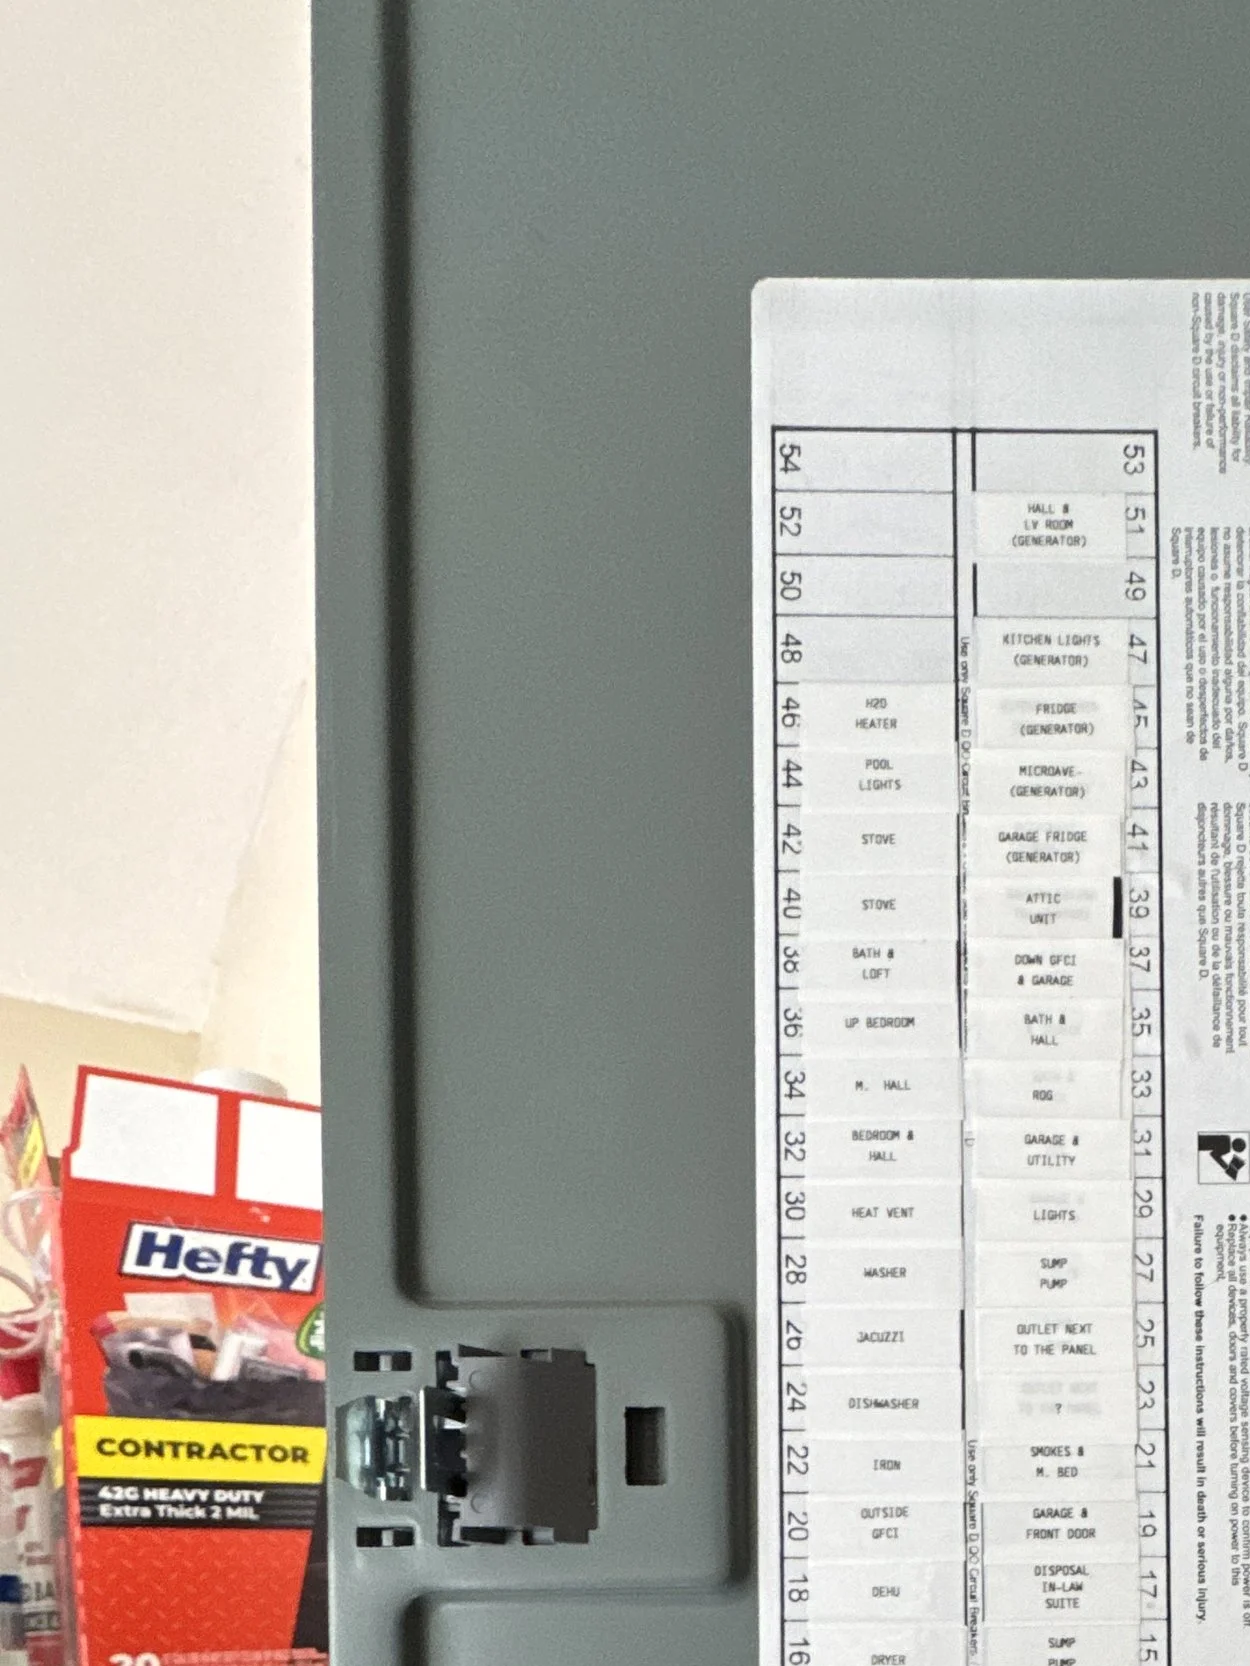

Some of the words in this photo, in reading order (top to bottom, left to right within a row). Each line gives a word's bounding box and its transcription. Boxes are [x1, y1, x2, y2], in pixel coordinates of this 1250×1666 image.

[780, 444, 801, 473] 54
[1123, 445, 1145, 475] 53
[1028, 504, 1054, 514] HALL
[1012, 535, 1086, 547] (GENERATOR)
[1125, 572, 1146, 601] 49
[1003, 634, 1051, 645] KITCHEN
[1058, 634, 1100, 647] LIGHTS
[1014, 654, 1088, 667] (GENERATOR)
[1036, 703, 1076, 714] FRIDGE
[856, 718, 897, 729] HEATER
[1020, 723, 1094, 736] (GENERATOR)
[866, 759, 893, 770] POOL
[859, 779, 901, 791] LIGHTS
[1011, 786, 1085, 798] (GENERATOR)
[862, 834, 895, 844] STOVE
[999, 832, 1038, 842] GARAGE
[1046, 831, 1086, 842] FRIDGE
[1007, 851, 1079, 863] (GENERATOR)
[1026, 892, 1060, 904] ATTIC
[862, 899, 895, 910] STOVE
[1030, 913, 1056, 924] UNIT
[853, 948, 880, 959] BATH
[1050, 955, 1075, 966] GFCI
[863, 968, 889, 980] LOFT
[1032, 975, 1072, 986] GARAGE
[845, 1017, 859, 1028] UP
[866, 1017, 915, 1028] BEDROOM
[1024, 1014, 1052, 1024] BATH
[1031, 1036, 1057, 1045] HALL
[884, 1081, 910, 1090] HALL
[852, 1130, 900, 1141] BEDROOM
[1025, 1134, 1064, 1145] GARAGE
[870, 1152, 896, 1161] HALL
[852, 1207, 878, 1218] HEAT
[887, 1207, 914, 1218] VENT
[1034, 1209, 1075, 1221] LIGHTS
[135, 1231, 311, 1291] Hefty
[864, 1267, 906, 1278] WASHER
[1017, 1323, 1058, 1335] OUTLET
[1065, 1323, 1092, 1334] NEXT
[1014, 1344, 1027, 1355] TO
[1035, 1344, 1054, 1355] THE
[1062, 1344, 1095, 1355] PANEL
[787, 1382, 806, 1412] 24
[849, 1398, 919, 1409] DISHWASHER
[96, 1438, 309, 1464] CONTRACTOR
[1031, 1446, 1071, 1457] SMOKES
[1058, 1467, 1078, 1477] BED
[98, 1486, 140, 1500] 42G
[143, 1488, 209, 1501] HEAVY
[213, 1489, 265, 1503] DUTY
[99, 1504, 152, 1519] Extra
[157, 1505, 207, 1520] Thick
[209, 1506, 222, 1520] 2
[225, 1507, 259, 1521] MIL
[861, 1506, 908, 1519] OUTSIDE
[1033, 1508, 1072, 1518] GARAGE
[872, 1527, 898, 1539] GFCI
[1027, 1529, 1060, 1539] FRONT
[1068, 1528, 1095, 1539] DOOR
[1035, 1565, 1089, 1576] DISPOSAL
[1043, 1582, 1083, 1592] IN-LAW
[1045, 1598, 1079, 1609] SUITE
[872, 1655, 905, 1665] DRYER
